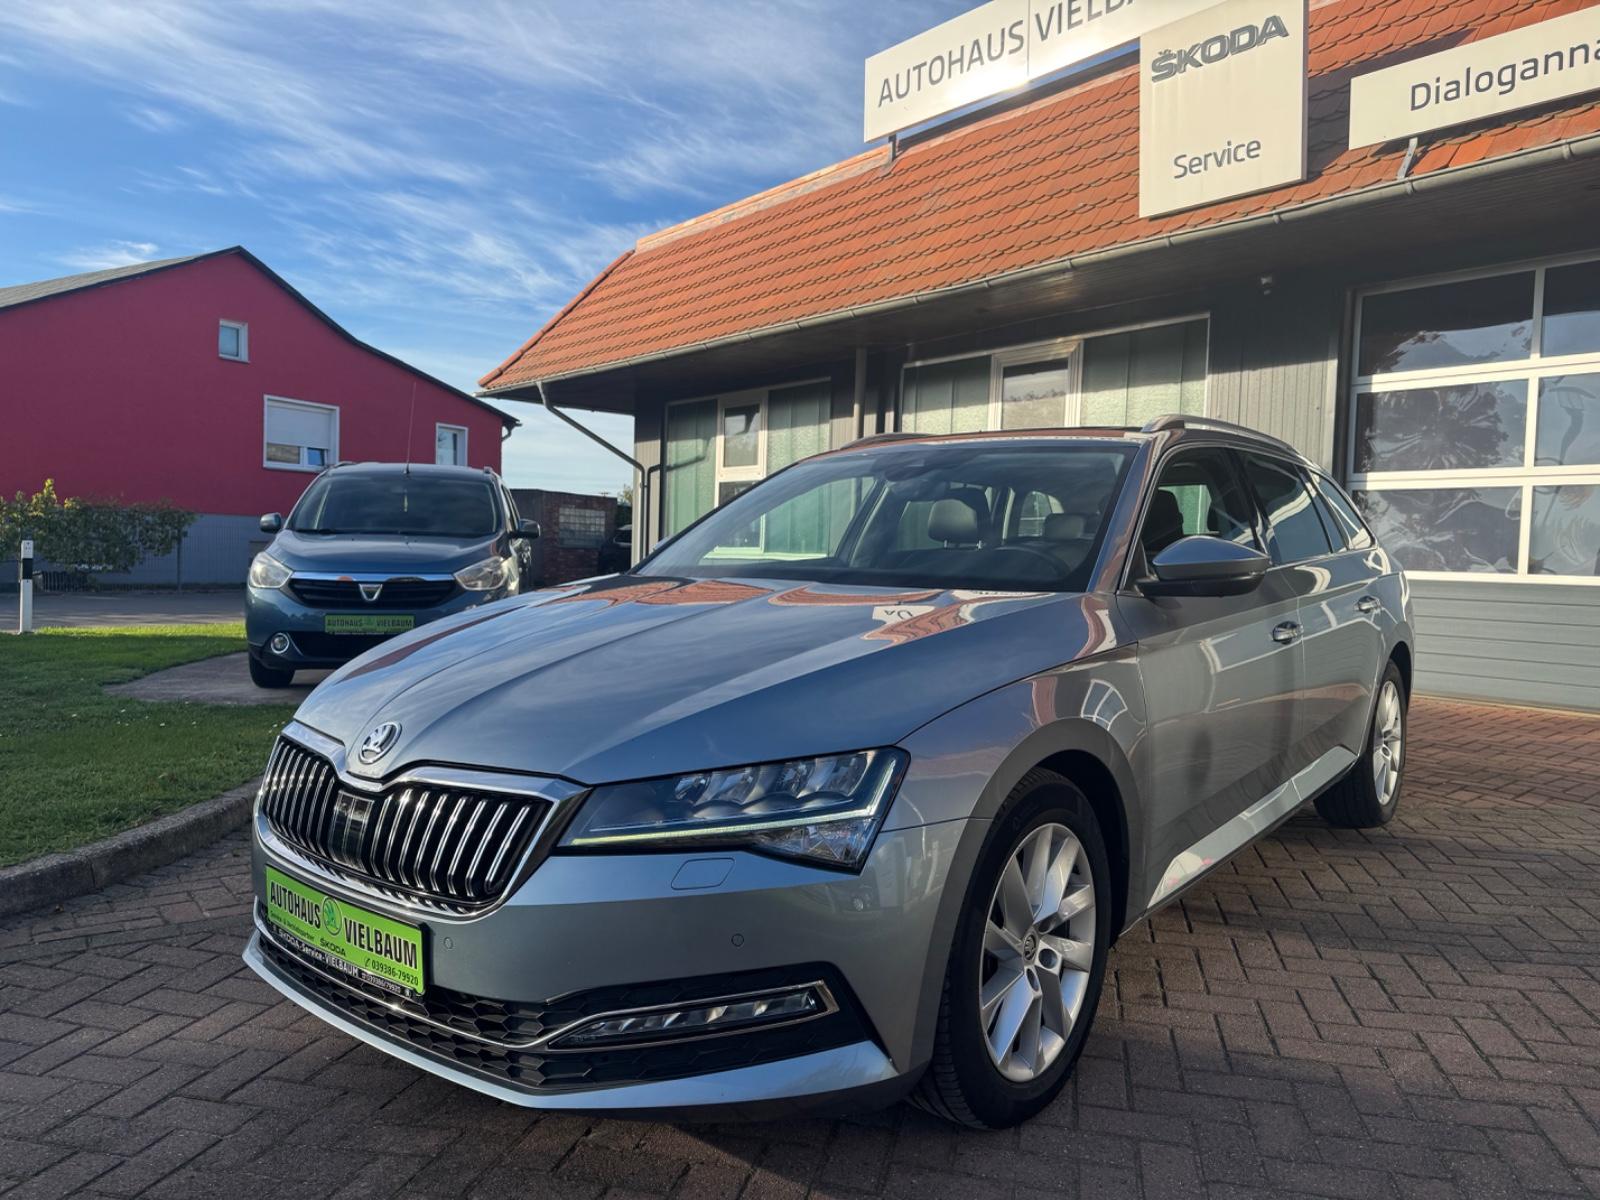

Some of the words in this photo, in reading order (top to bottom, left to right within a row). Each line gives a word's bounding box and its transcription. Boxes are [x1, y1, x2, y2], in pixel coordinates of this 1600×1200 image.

[878, 19, 1025, 108] AUTOHAUS
[1034, 0, 1134, 42] VIEL
[1151, 15, 1289, 83] ŠKODA
[1173, 139, 1262, 180] Service
[270, 881, 321, 930] AUTOHAUS
[344, 916, 418, 970] VIELBAUM
